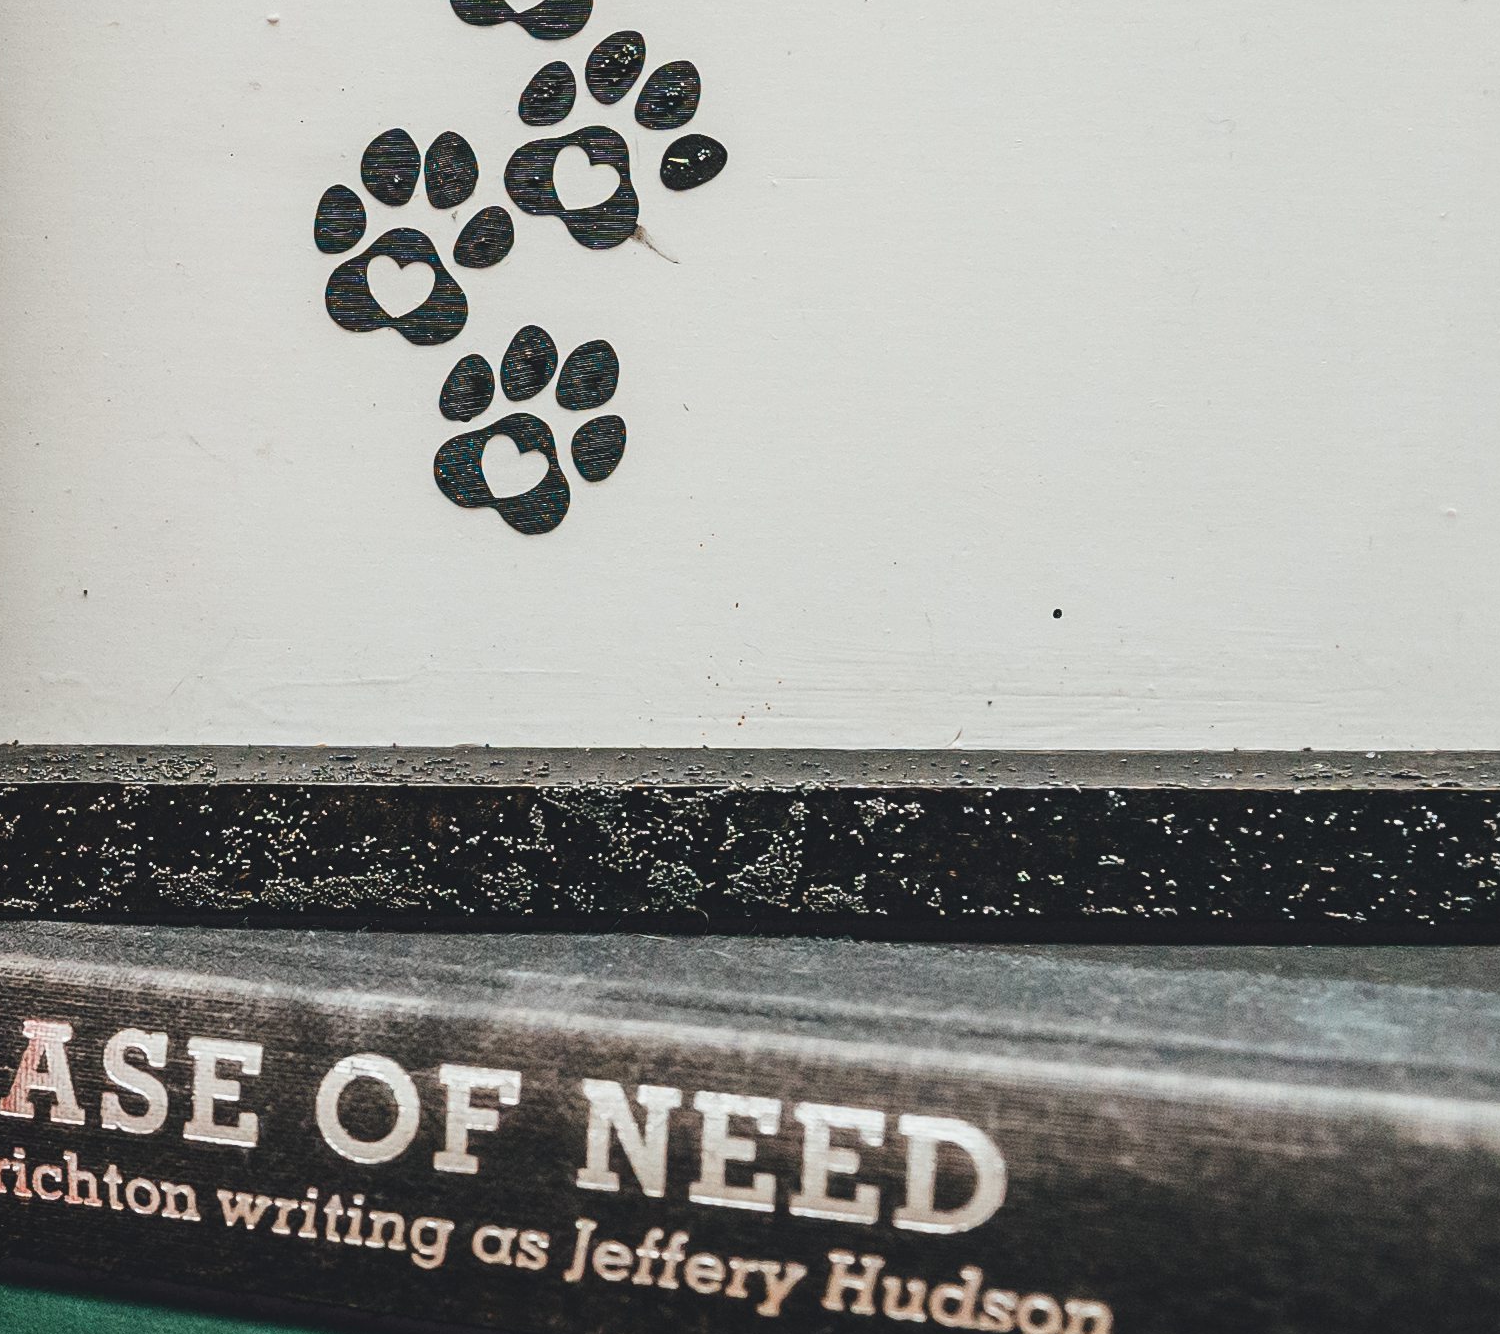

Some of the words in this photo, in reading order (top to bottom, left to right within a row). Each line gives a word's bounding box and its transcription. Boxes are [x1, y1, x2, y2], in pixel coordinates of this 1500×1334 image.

[316, 1052, 524, 1174] OF
[576, 1078, 1010, 1235] NEED
[218, 1187, 455, 1269] writing
[472, 1225, 549, 1270] as
[565, 1221, 807, 1315] Jeffery
